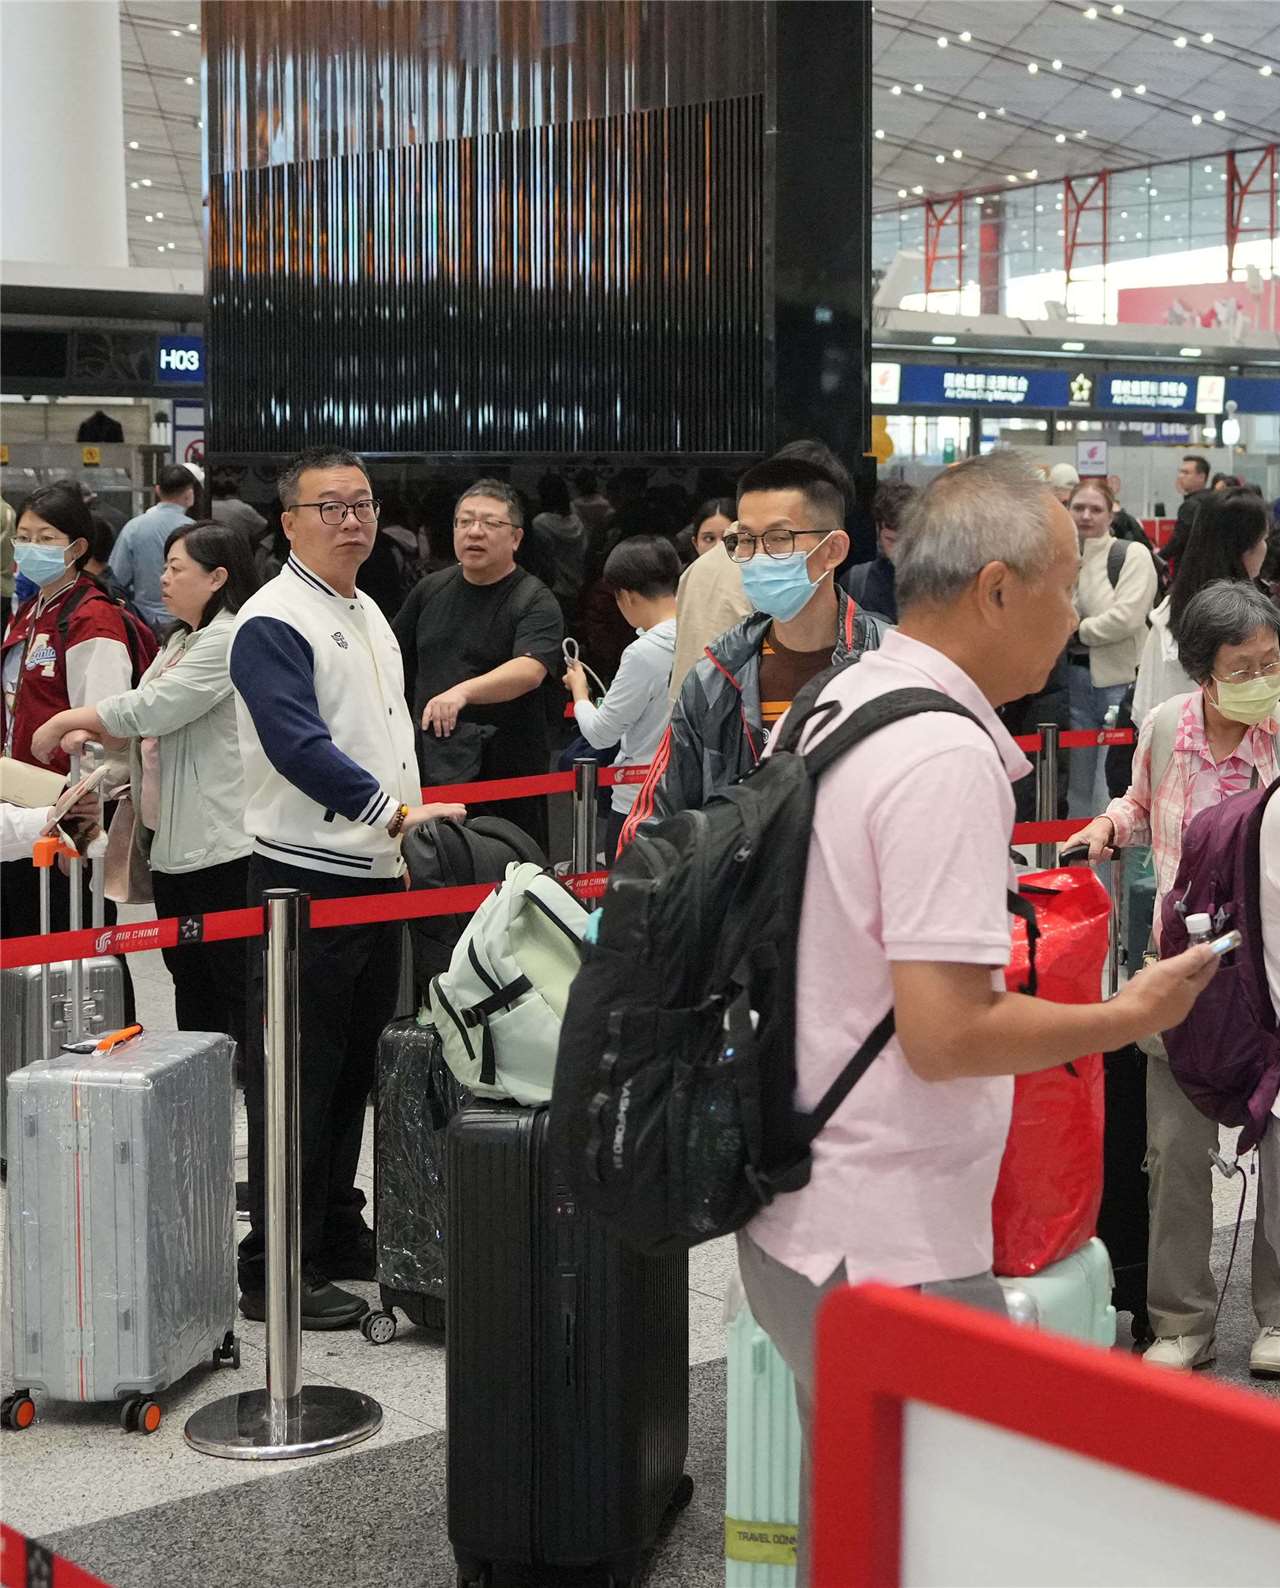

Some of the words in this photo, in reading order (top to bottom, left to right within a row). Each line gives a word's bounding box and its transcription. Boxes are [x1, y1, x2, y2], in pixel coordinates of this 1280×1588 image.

[160, 349, 199, 371] H03
[589, 877, 608, 886] CHIN
[115, 930, 131, 941] AIR
[132, 927, 160, 939] CHINA
[736, 1531, 772, 1544] TRAVEL
